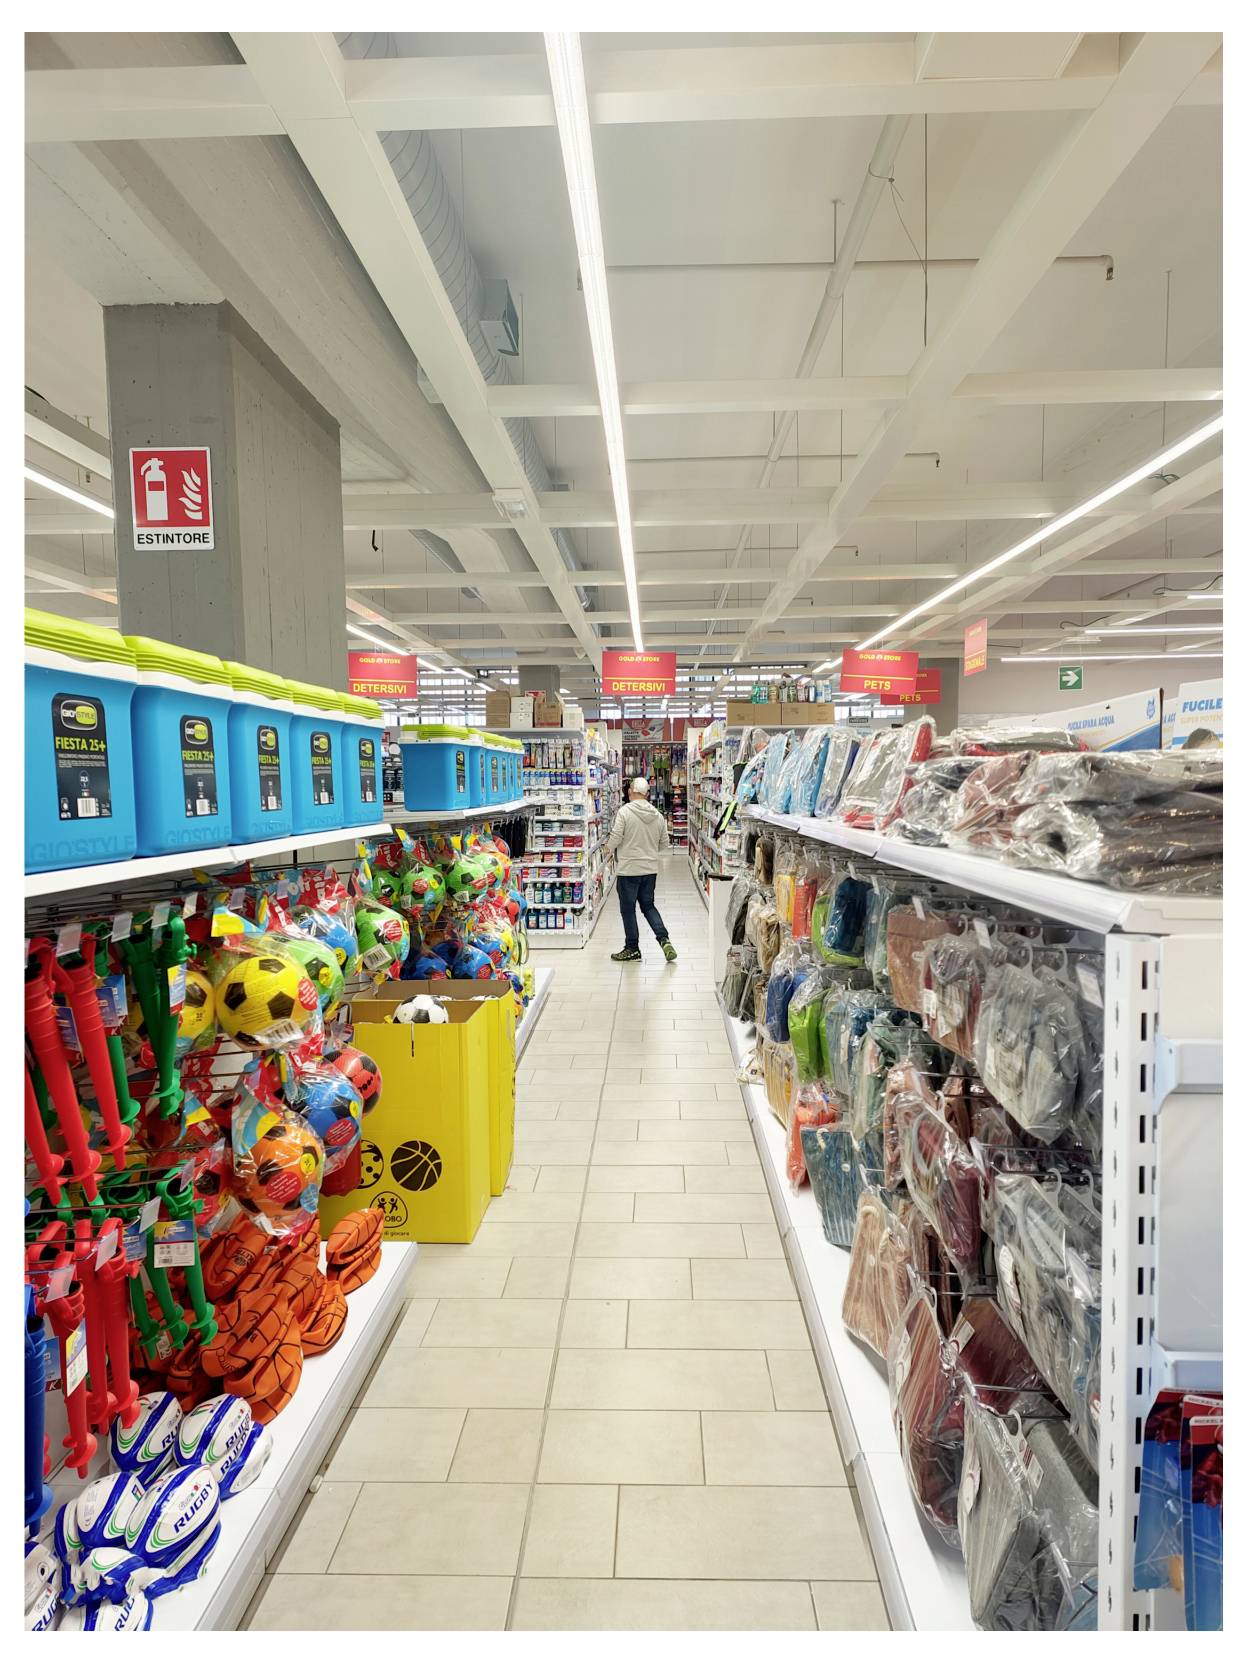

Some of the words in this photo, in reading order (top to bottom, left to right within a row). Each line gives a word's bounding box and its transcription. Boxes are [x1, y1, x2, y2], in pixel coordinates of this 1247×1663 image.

[137, 532, 210, 544] ESTINTORE
[353, 683, 407, 694] DETERSIVI
[612, 681, 666, 692] DETERSIVI
[863, 680, 891, 690] PETS
[899, 693, 922, 702] PETS
[1182, 697, 1223, 713] FUCILE
[55, 736, 88, 751] FIESTA
[90, 739, 106, 752] 25+
[182, 750, 203, 761] FIESTA
[203, 751, 214, 761] 25+
[173, 1481, 213, 1534] RUGBY
